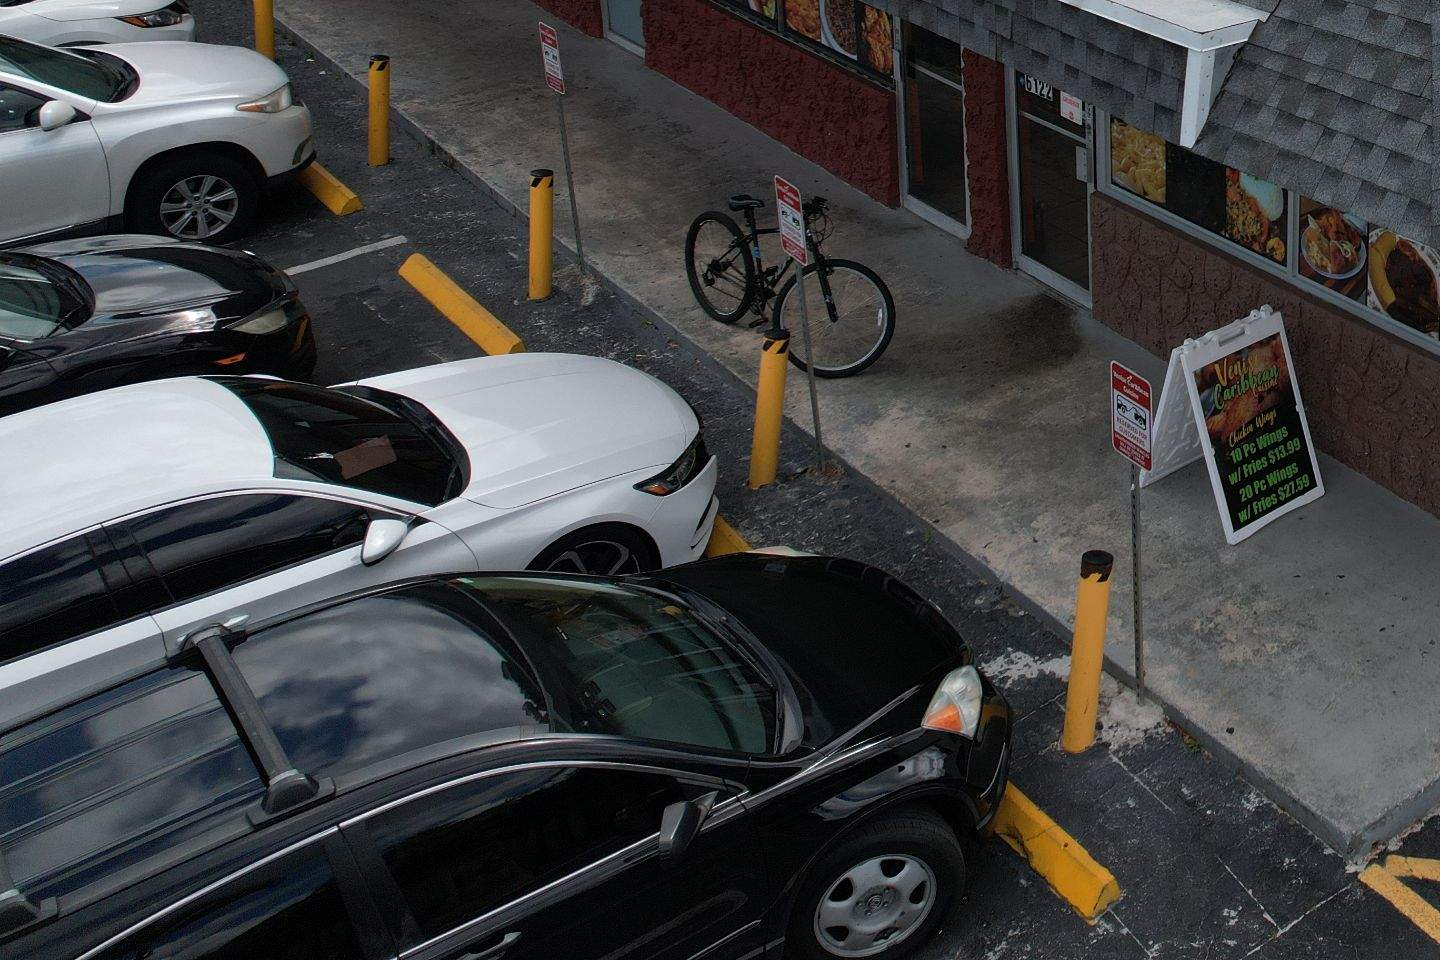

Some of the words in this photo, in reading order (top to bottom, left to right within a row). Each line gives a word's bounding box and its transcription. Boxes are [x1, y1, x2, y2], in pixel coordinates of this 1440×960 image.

[1228, 466, 1241, 485] w/
[1242, 456, 1268, 478] Fries
[1268, 437, 1301, 465] $13.99
[1230, 447, 1243, 464] 10
[1256, 426, 1289, 450] Wings
[1239, 484, 1253, 503] 20
[1266, 462, 1299, 487] Wings
[1238, 504, 1251, 523] w/
[1252, 493, 1278, 515] Fries
